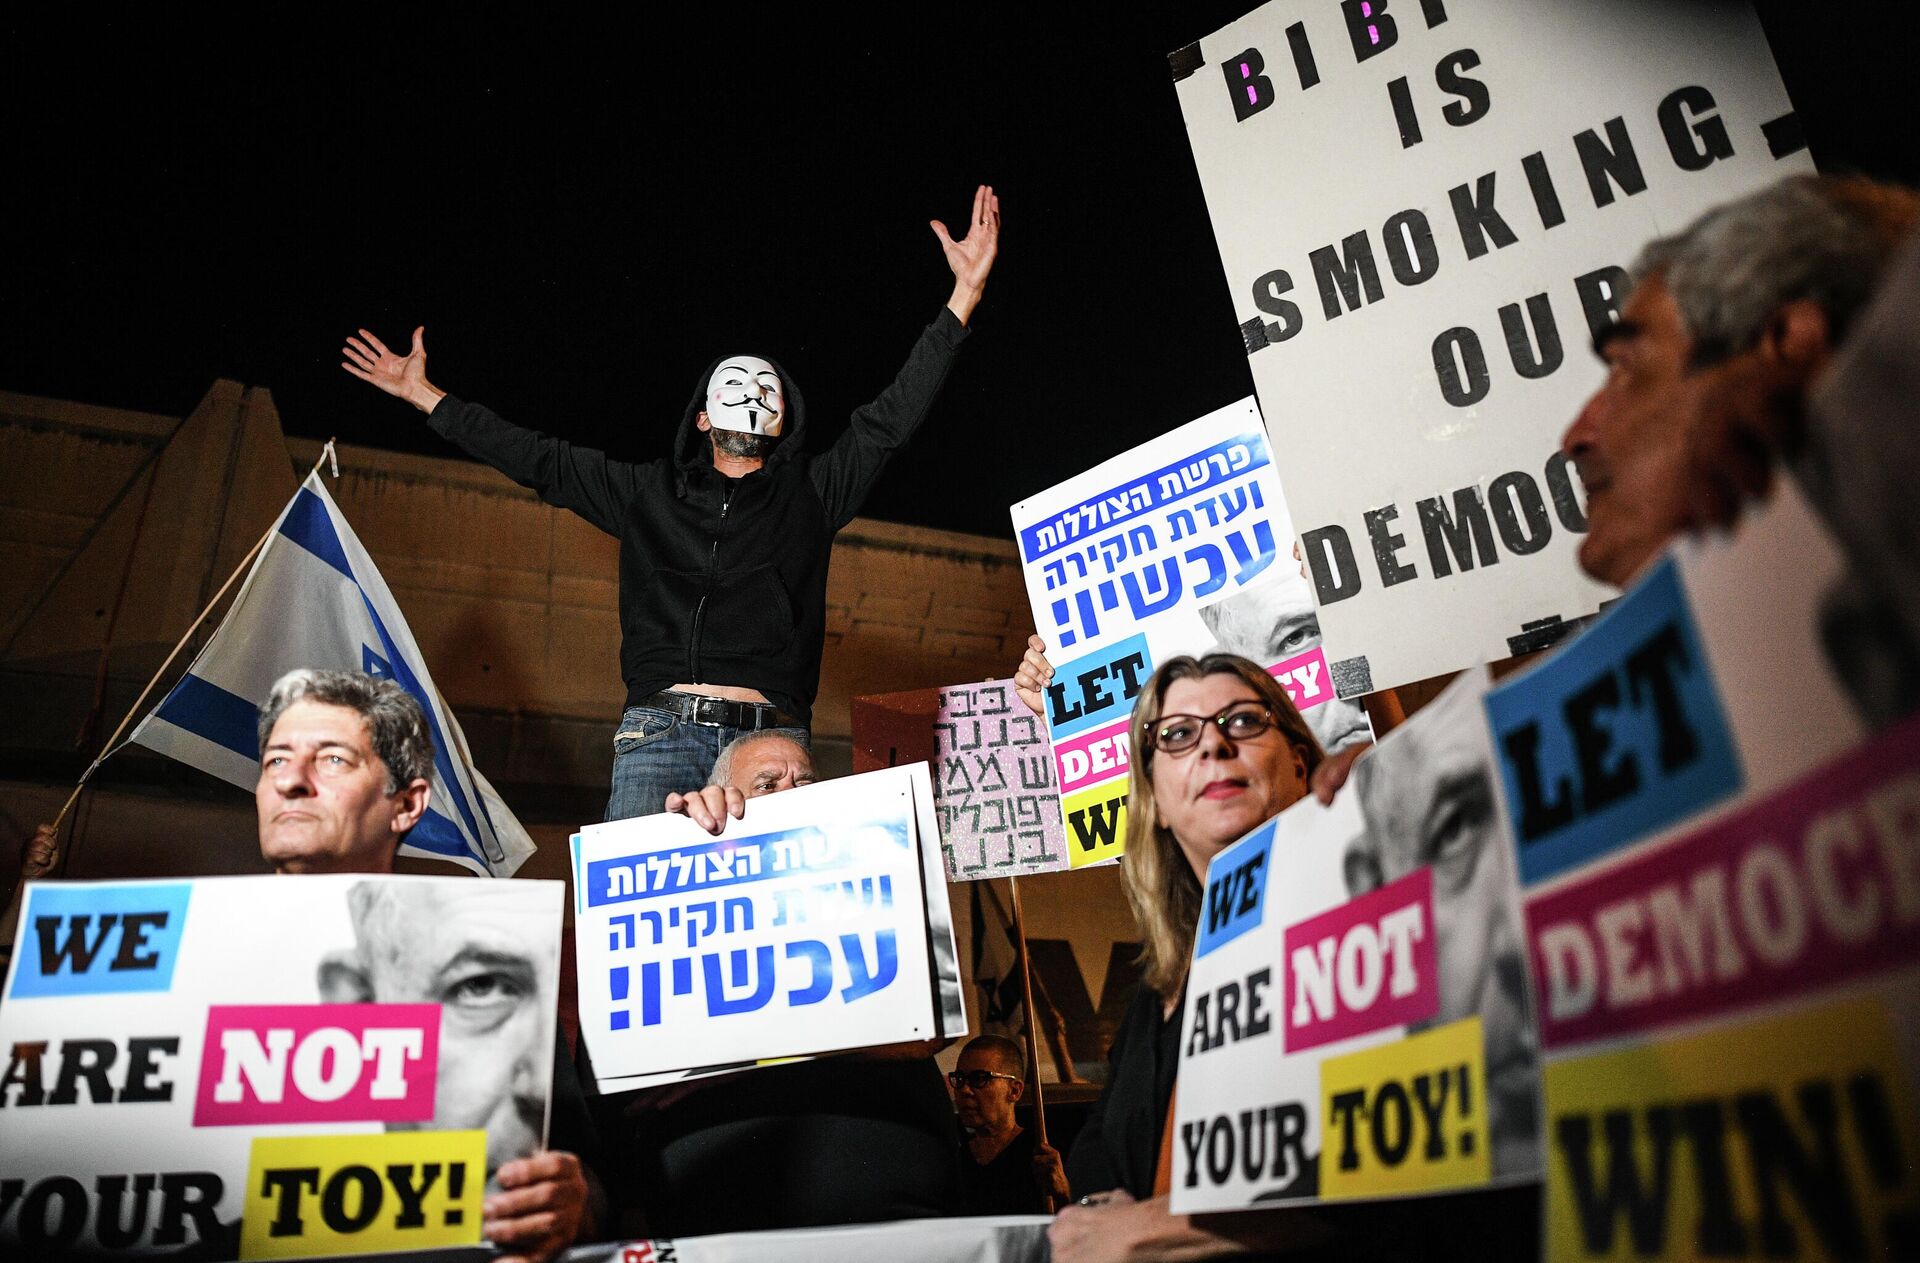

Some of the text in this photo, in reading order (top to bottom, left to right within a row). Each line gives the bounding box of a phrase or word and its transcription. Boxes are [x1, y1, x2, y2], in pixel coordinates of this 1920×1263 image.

[1387, 48, 1491, 149] IS
[1252, 85, 1735, 343] SMOKING
[1036, 444, 1251, 553] פרשת הצוללות
[1044, 480, 1264, 591] ועדת חקירה
[1051, 519, 1277, 648] עכשיו!
[1048, 651, 1144, 727] LET
[1505, 623, 1699, 841] LET
[607, 844, 761, 898] הצוללות
[1207, 852, 1264, 934] WE
[35, 910, 168, 976] WE
[609, 896, 754, 951] חקירה
[1291, 903, 1423, 1028] NOT
[609, 928, 898, 1031] עכשיו!
[1187, 967, 1270, 1057] ARE
[0, 1036, 180, 1107] ARE
[214, 1026, 424, 1103] NOT
[1181, 1101, 1313, 1188] YOUR
[1331, 1061, 1476, 1173] TOY!
[261, 1162, 467, 1238] TOY!
[1557, 1070, 1920, 1260] WIN!
